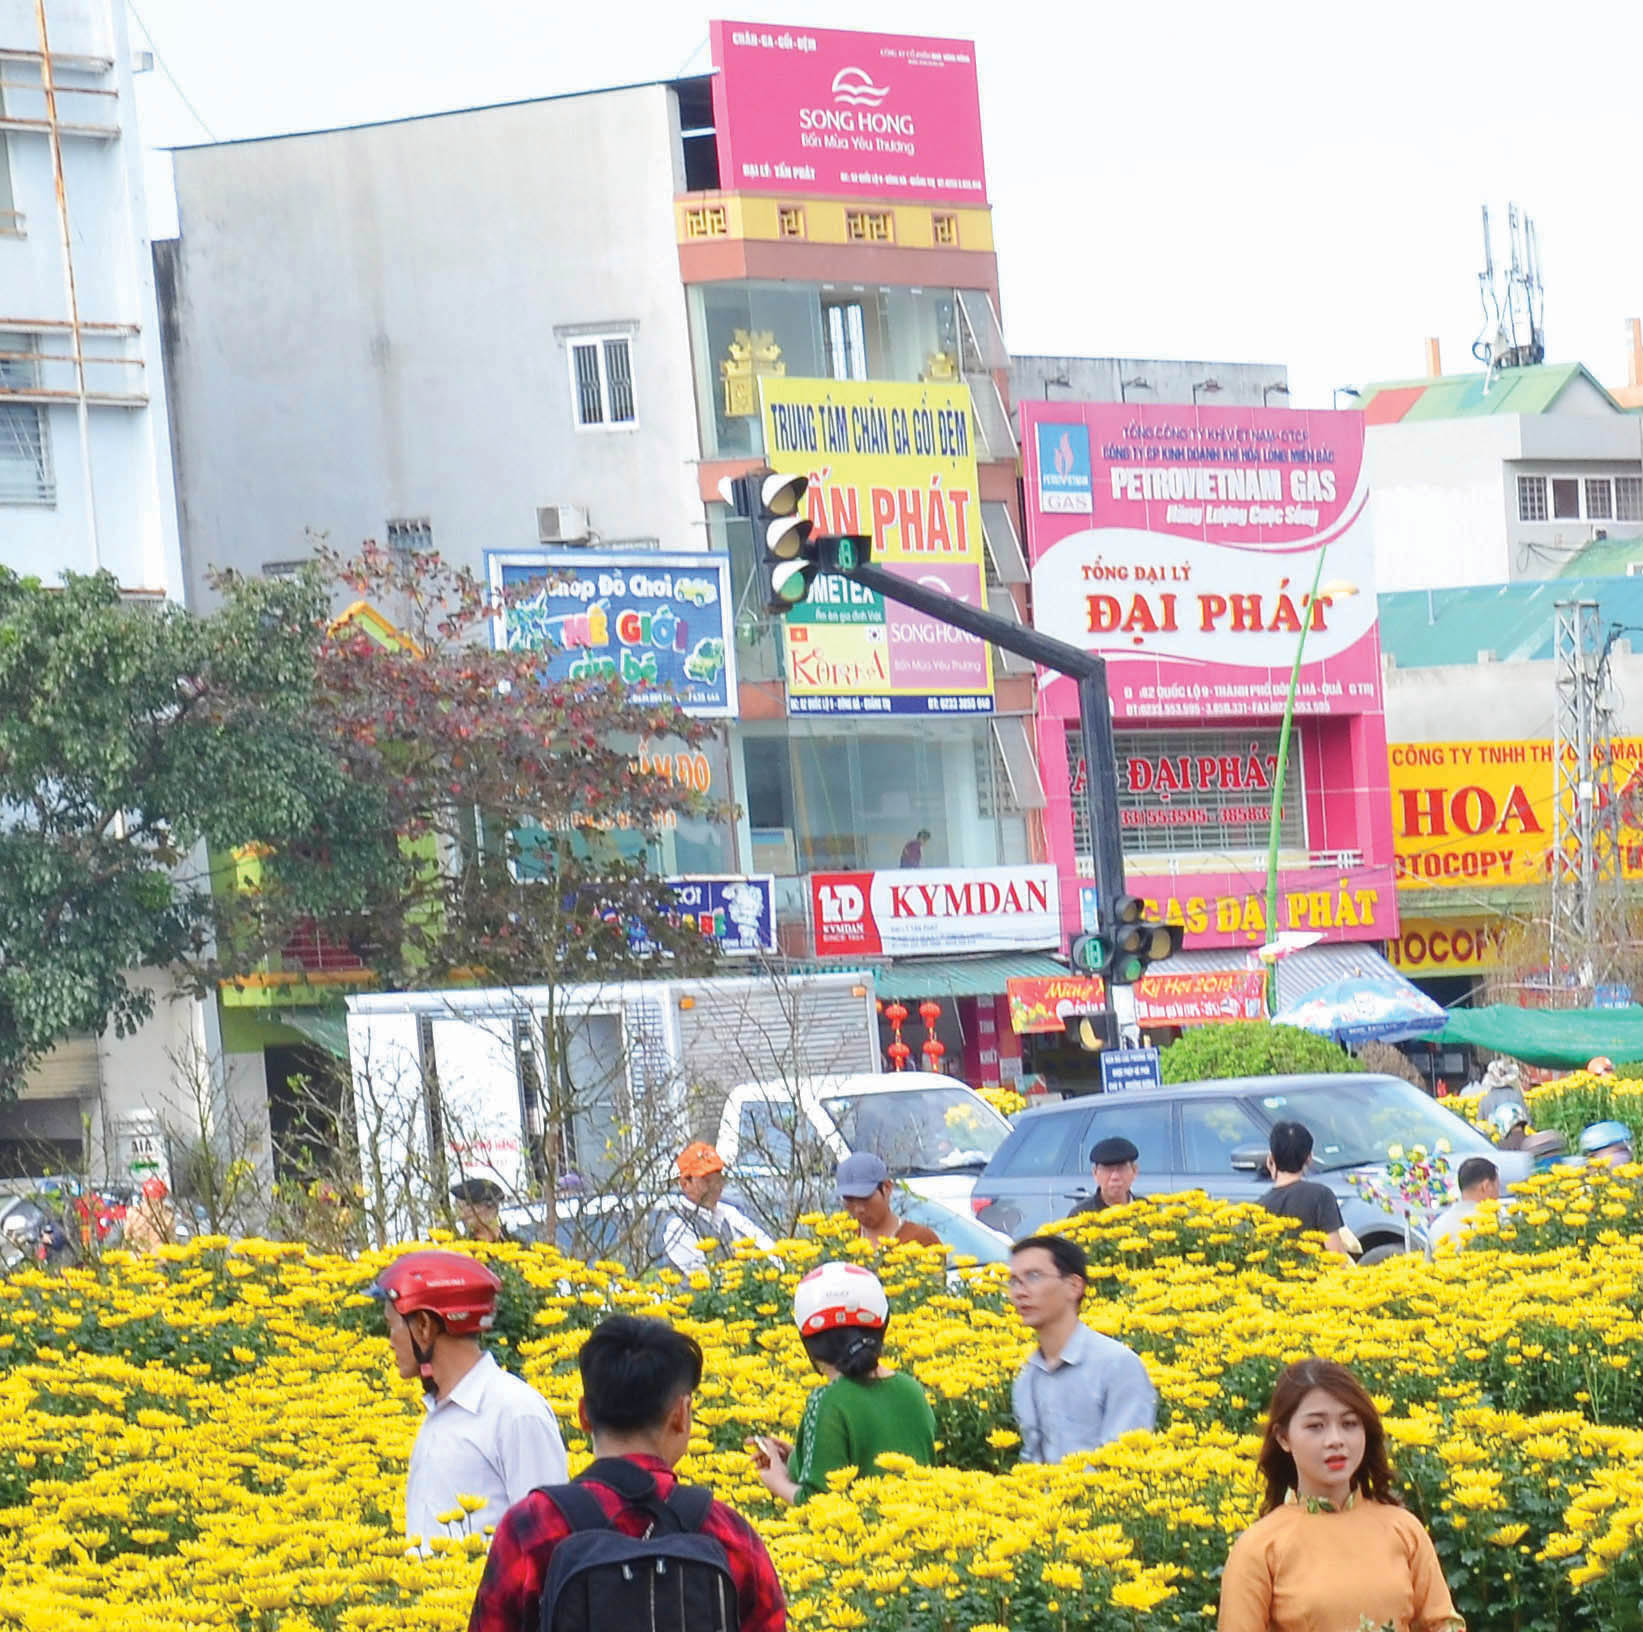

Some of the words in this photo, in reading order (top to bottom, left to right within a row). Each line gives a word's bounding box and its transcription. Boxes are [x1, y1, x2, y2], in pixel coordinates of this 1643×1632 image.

[800, 109, 854, 132] SONG
[858, 113, 914, 136] HONG
[771, 404, 818, 452] TRUNG
[819, 393, 850, 453] TÂM
[852, 396, 890, 455] CHĂN
[891, 408, 911, 455] GA
[912, 391, 936, 457] GỐI
[938, 399, 969, 470] ĐỆM
[1047, 492, 1088, 509] GAS
[1110, 467, 1282, 501] PETROVIETNAM
[1290, 469, 1337, 502] GAS
[798, 467, 860, 543] ẤN
[871, 475, 970, 552] PHÁT
[597, 568, 626, 598] Đồ
[1081, 555, 1129, 581] TỔNG
[1134, 564, 1166, 585] ĐẠI
[1172, 560, 1191, 581] LÝ
[1086, 593, 1179, 645] ĐẠI
[1198, 578, 1334, 633] PHÁT
[891, 623, 936, 643] SONG
[1392, 743, 1444, 766] CÔNG
[1449, 748, 1473, 765] TY
[1478, 746, 1526, 764] TNHH
[1128, 756, 1191, 801] ĐẠI
[1398, 784, 1545, 838] HOA
[1394, 849, 1514, 880] OTOCOPY
[889, 880, 1048, 919] KYMDAN
[1140, 897, 1209, 934] GAS
[1286, 877, 1378, 929] PHÁT
[1392, 926, 1506, 966] TOCOPY
